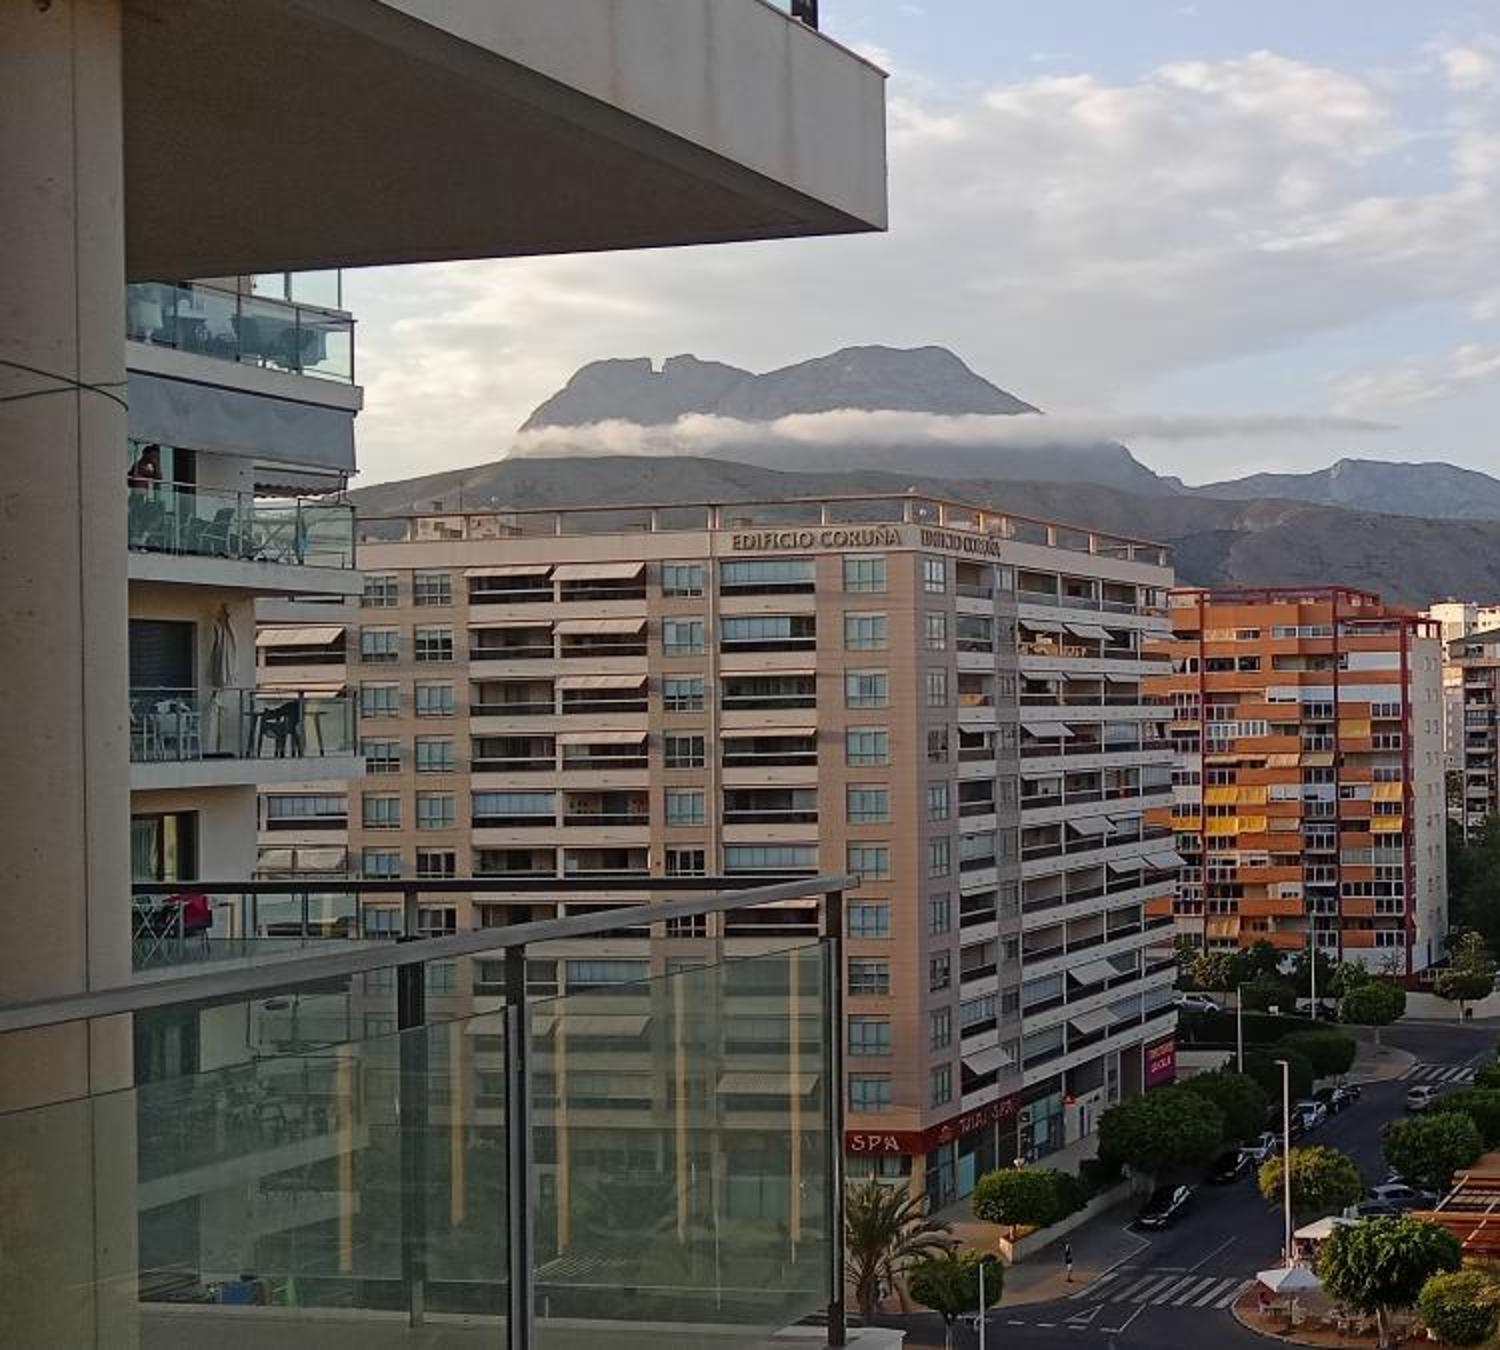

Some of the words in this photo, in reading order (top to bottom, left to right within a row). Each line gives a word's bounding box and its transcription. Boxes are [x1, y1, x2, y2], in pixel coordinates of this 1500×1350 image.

[732, 532, 815, 551] EDIFICIO
[820, 524, 902, 547] CORUÑA
[851, 1135, 900, 1151] SPA
